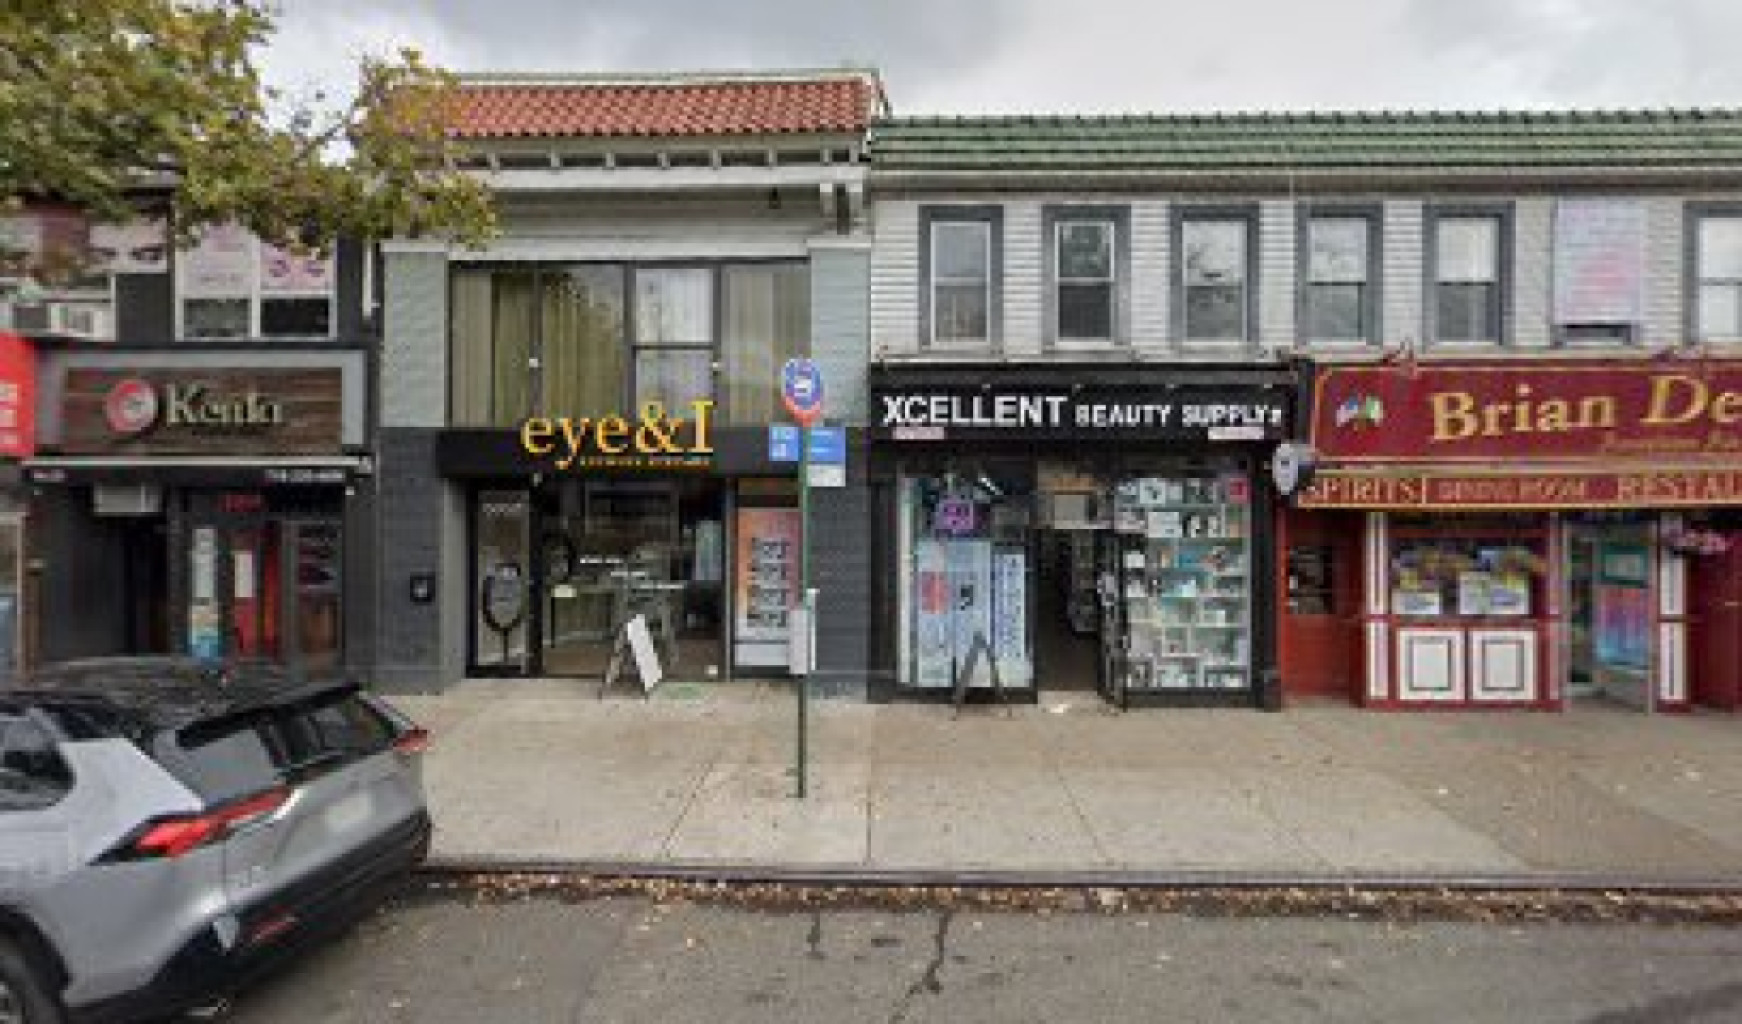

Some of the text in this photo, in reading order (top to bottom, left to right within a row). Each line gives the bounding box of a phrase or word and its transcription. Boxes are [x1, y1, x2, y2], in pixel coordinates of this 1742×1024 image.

[521, 400, 715, 471] eye&I
[882, 395, 1069, 427] XCELLENT
[1075, 404, 1172, 427] BEAUTY
[1431, 382, 1616, 440] Brian
